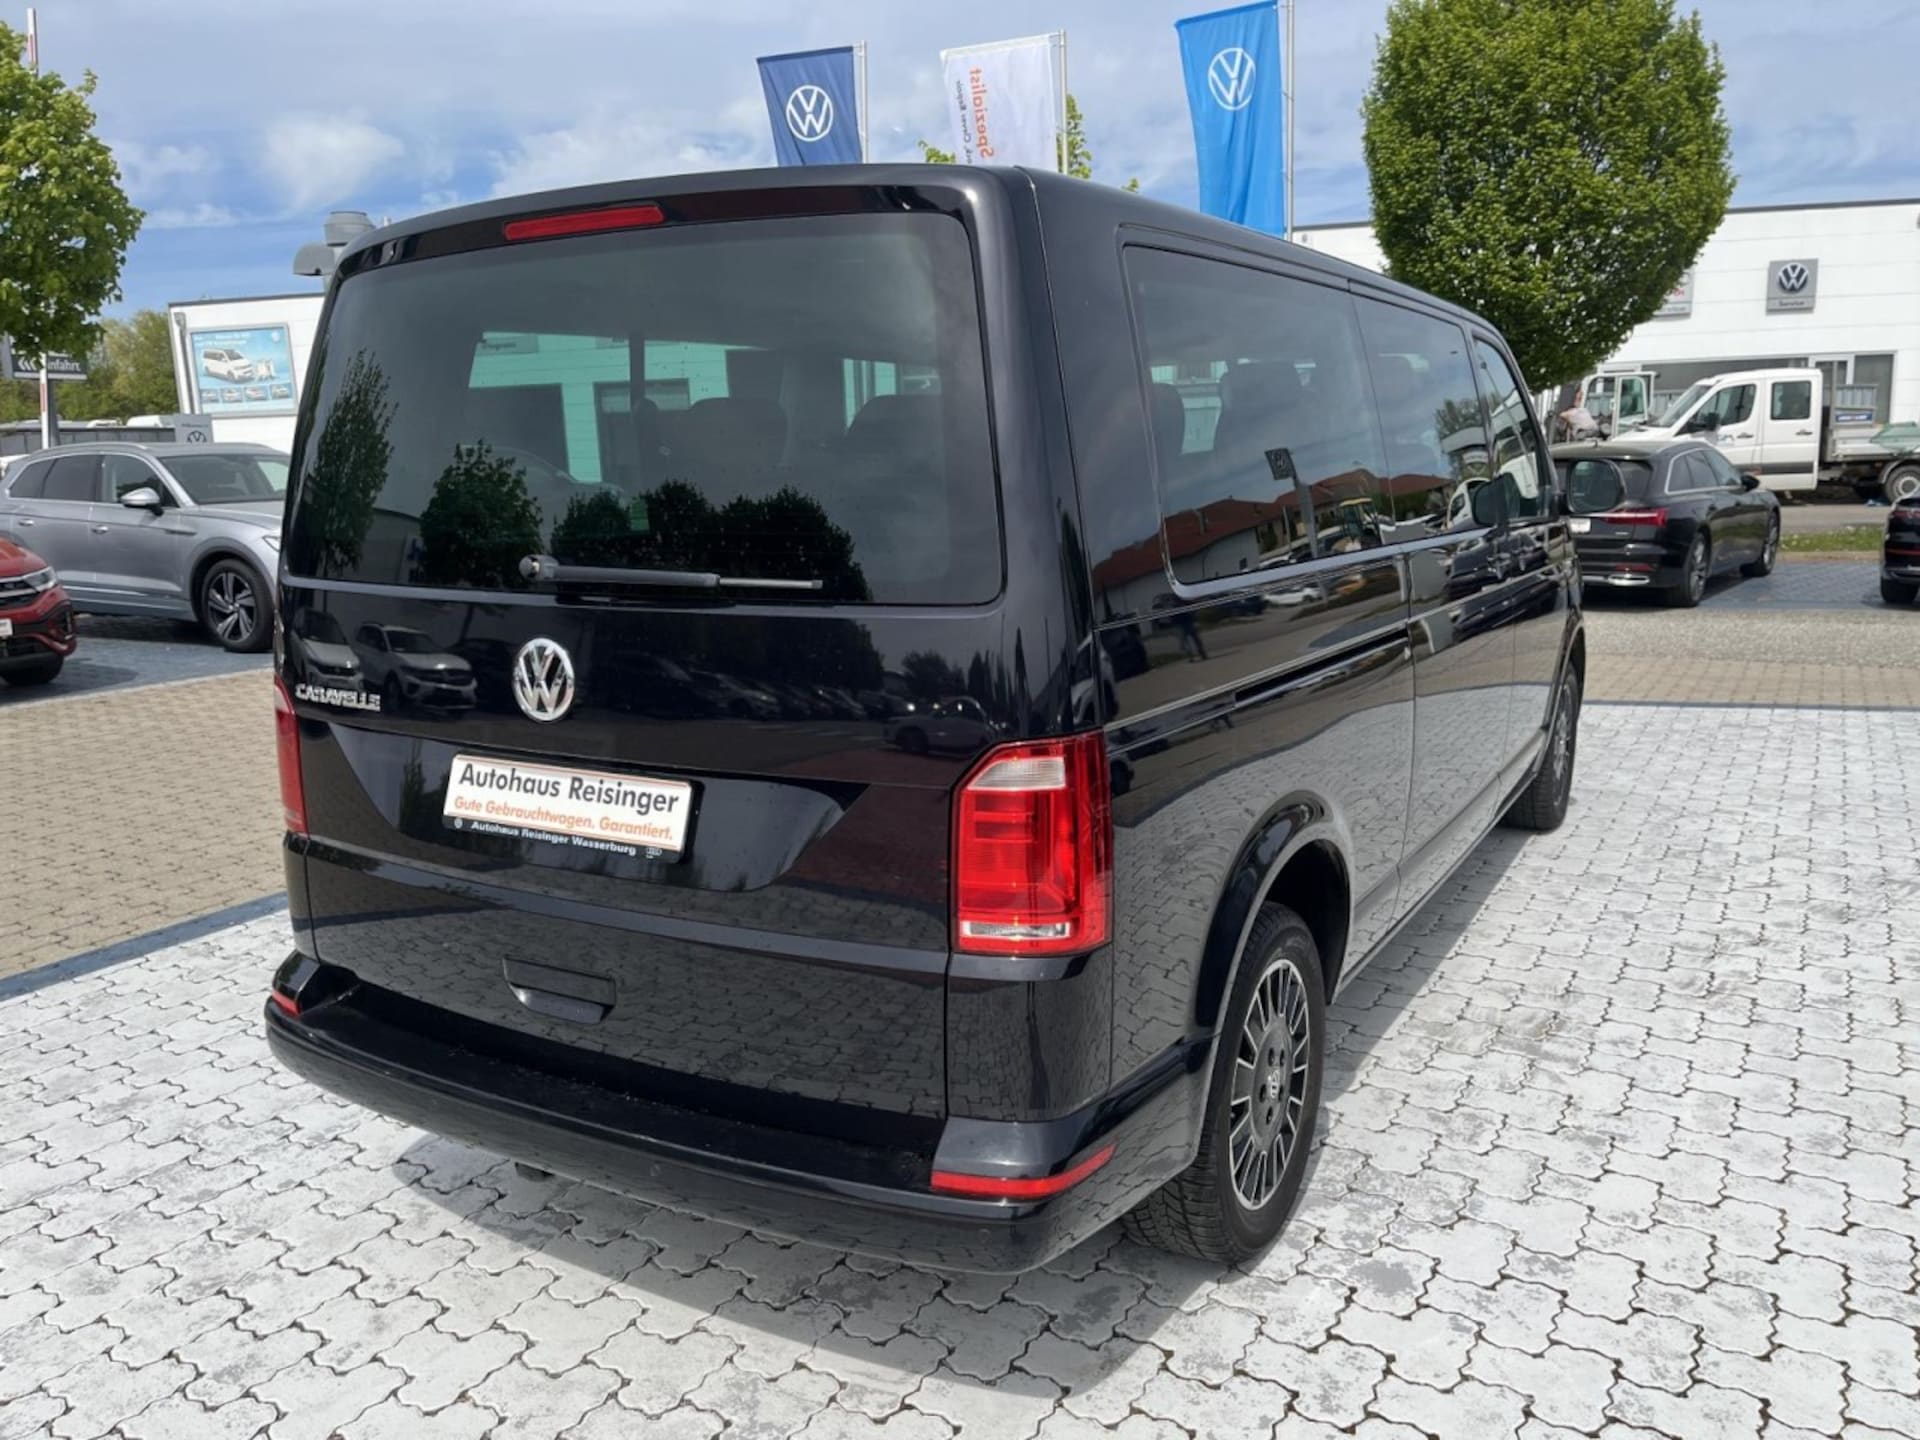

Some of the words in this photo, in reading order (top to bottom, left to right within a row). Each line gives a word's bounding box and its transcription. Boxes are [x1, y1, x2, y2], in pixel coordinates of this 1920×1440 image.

[1208, 47, 1257, 111] VW
[785, 84, 834, 142] VW
[1778, 262, 1809, 293] VW
[47, 359, 81, 371] infahrt
[295, 683, 381, 712] CARAVELLE
[512, 638, 574, 721] VW
[459, 763, 560, 797] Autohaus
[568, 777, 678, 816] Reisinger
[454, 797, 482, 813] Gute
[486, 800, 595, 829] Gebrauchtwagen.
[599, 816, 673, 841] Garantiert.
[471, 821, 519, 837] Autohaus
[521, 829, 569, 843] Reisinger
[572, 834, 636, 857] Wasserburg
